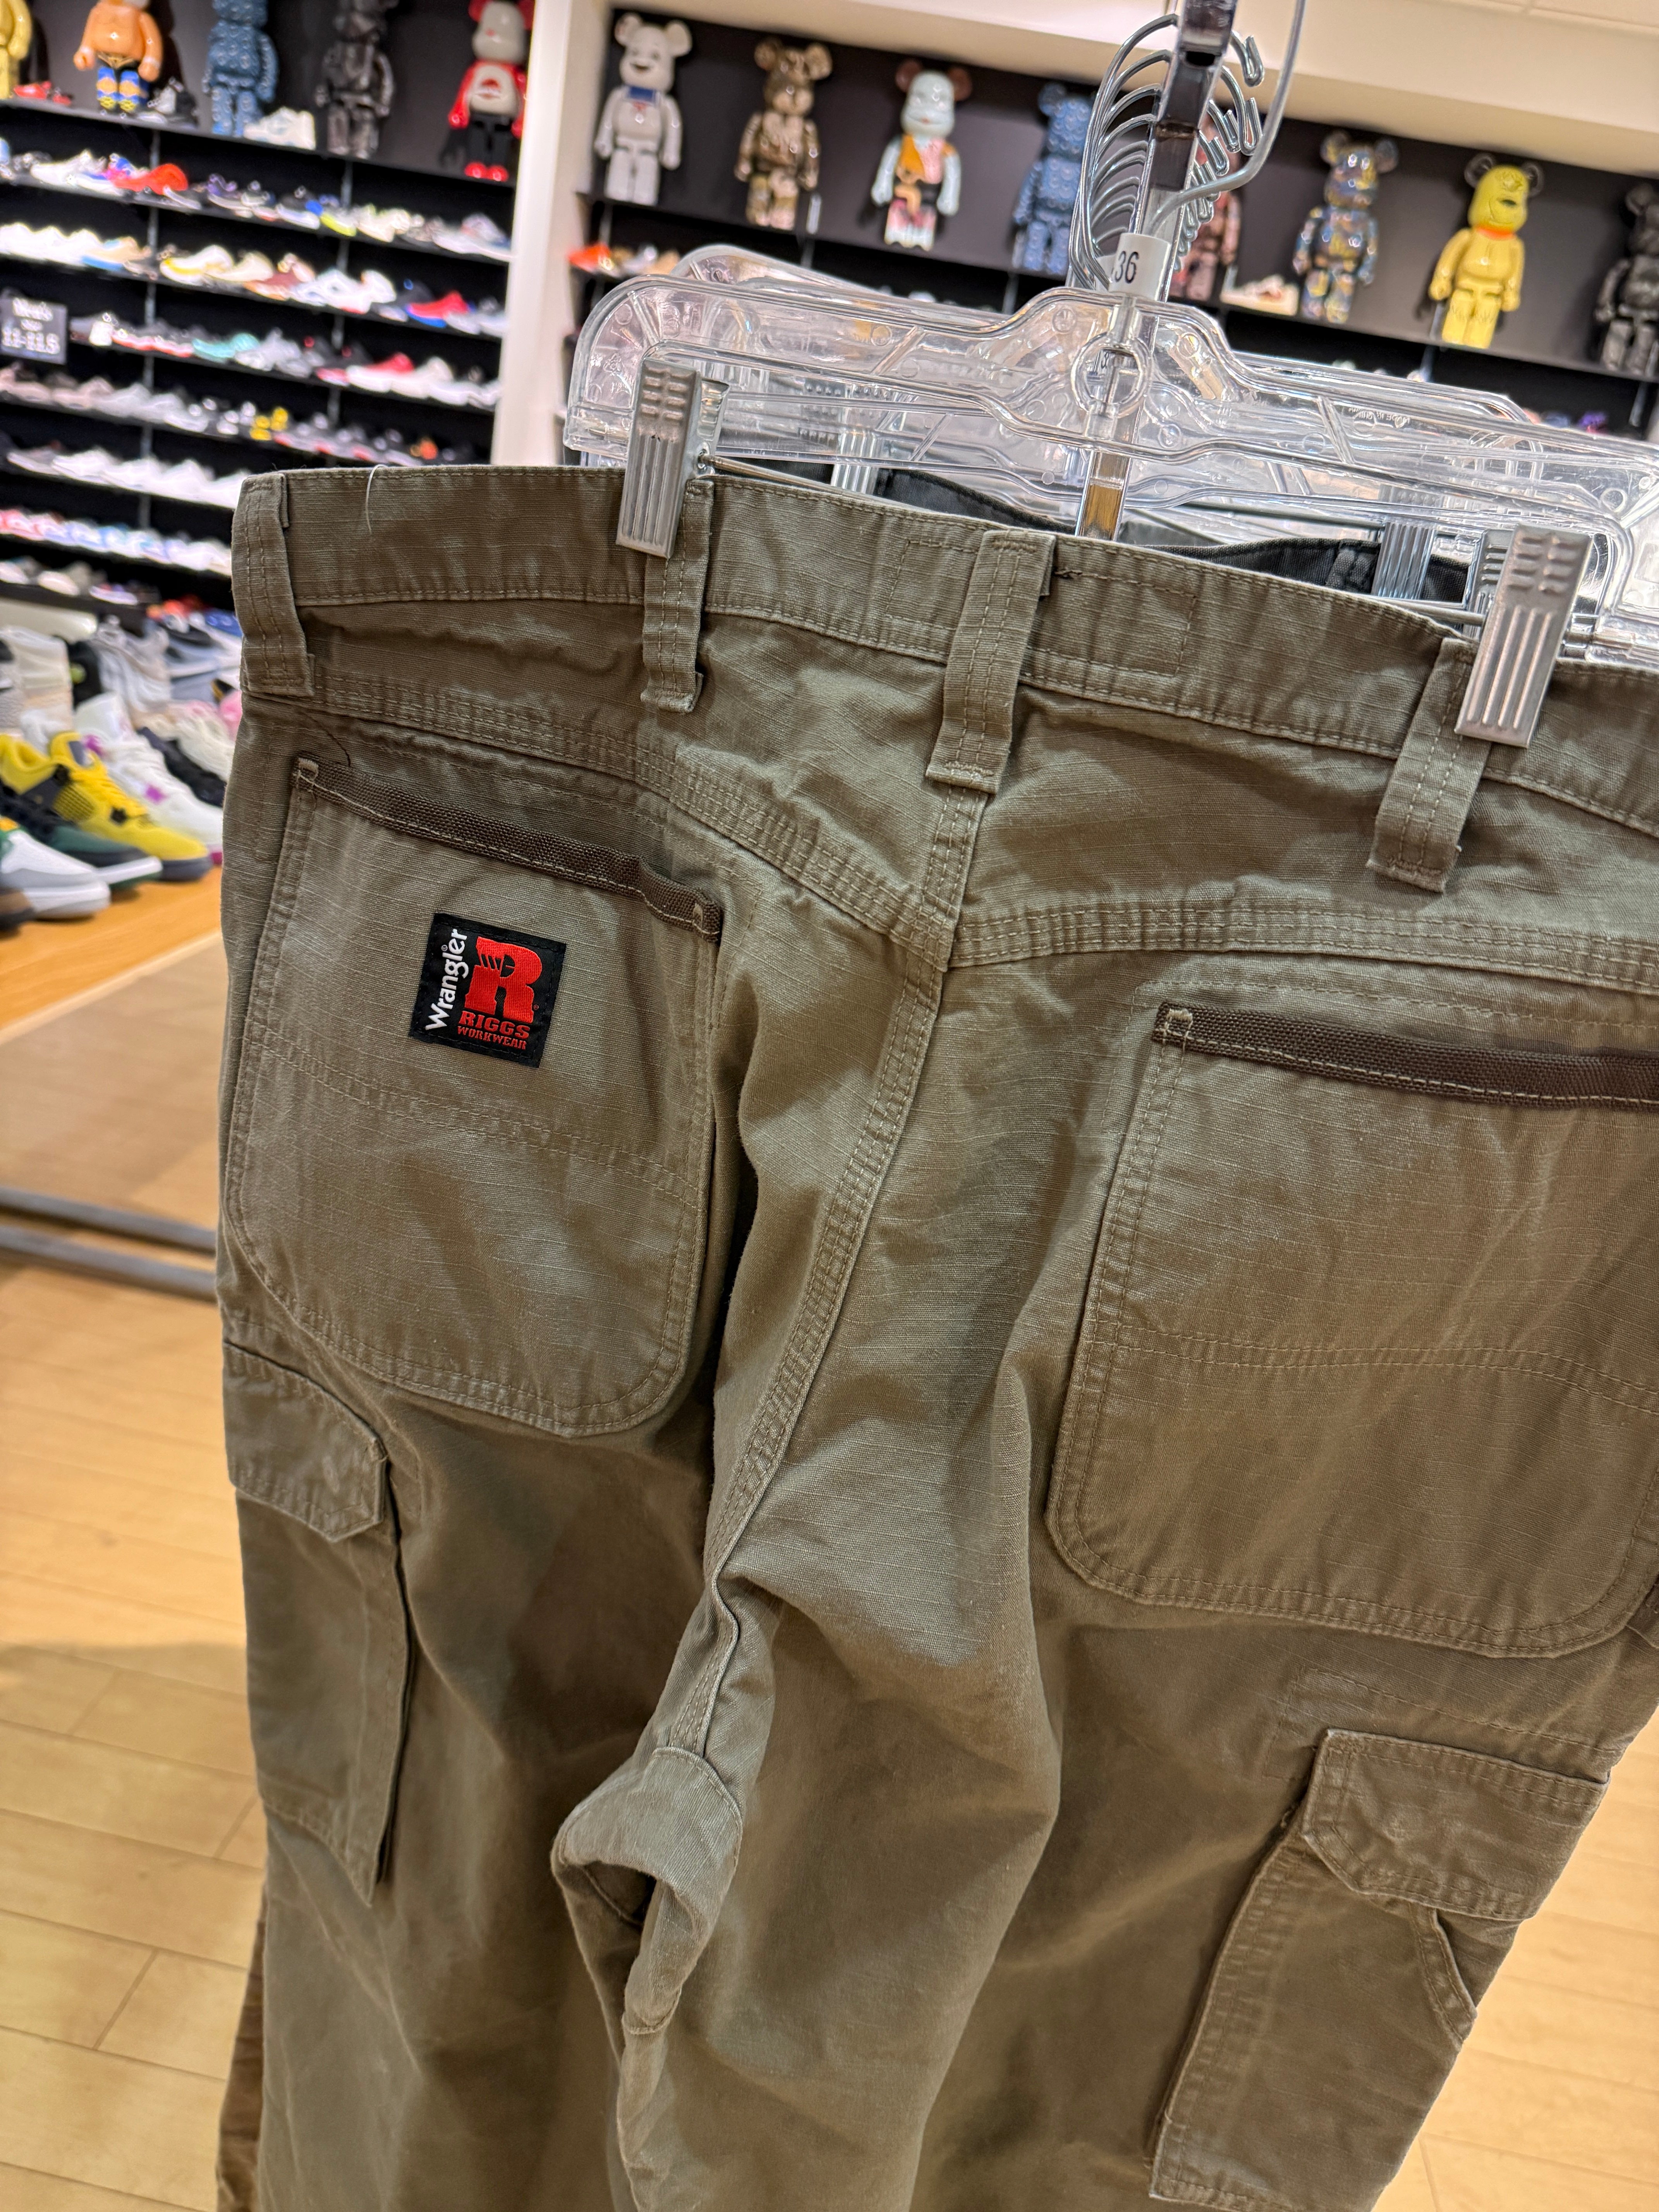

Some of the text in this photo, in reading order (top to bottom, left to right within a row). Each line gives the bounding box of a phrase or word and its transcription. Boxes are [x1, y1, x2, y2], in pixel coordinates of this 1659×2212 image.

[1114, 251, 1139, 283] 36
[426, 929, 469, 1030] Wrangler
[457, 1025, 526, 1050] WORKWEAR
[459, 1010, 530, 1039] RIGGS
